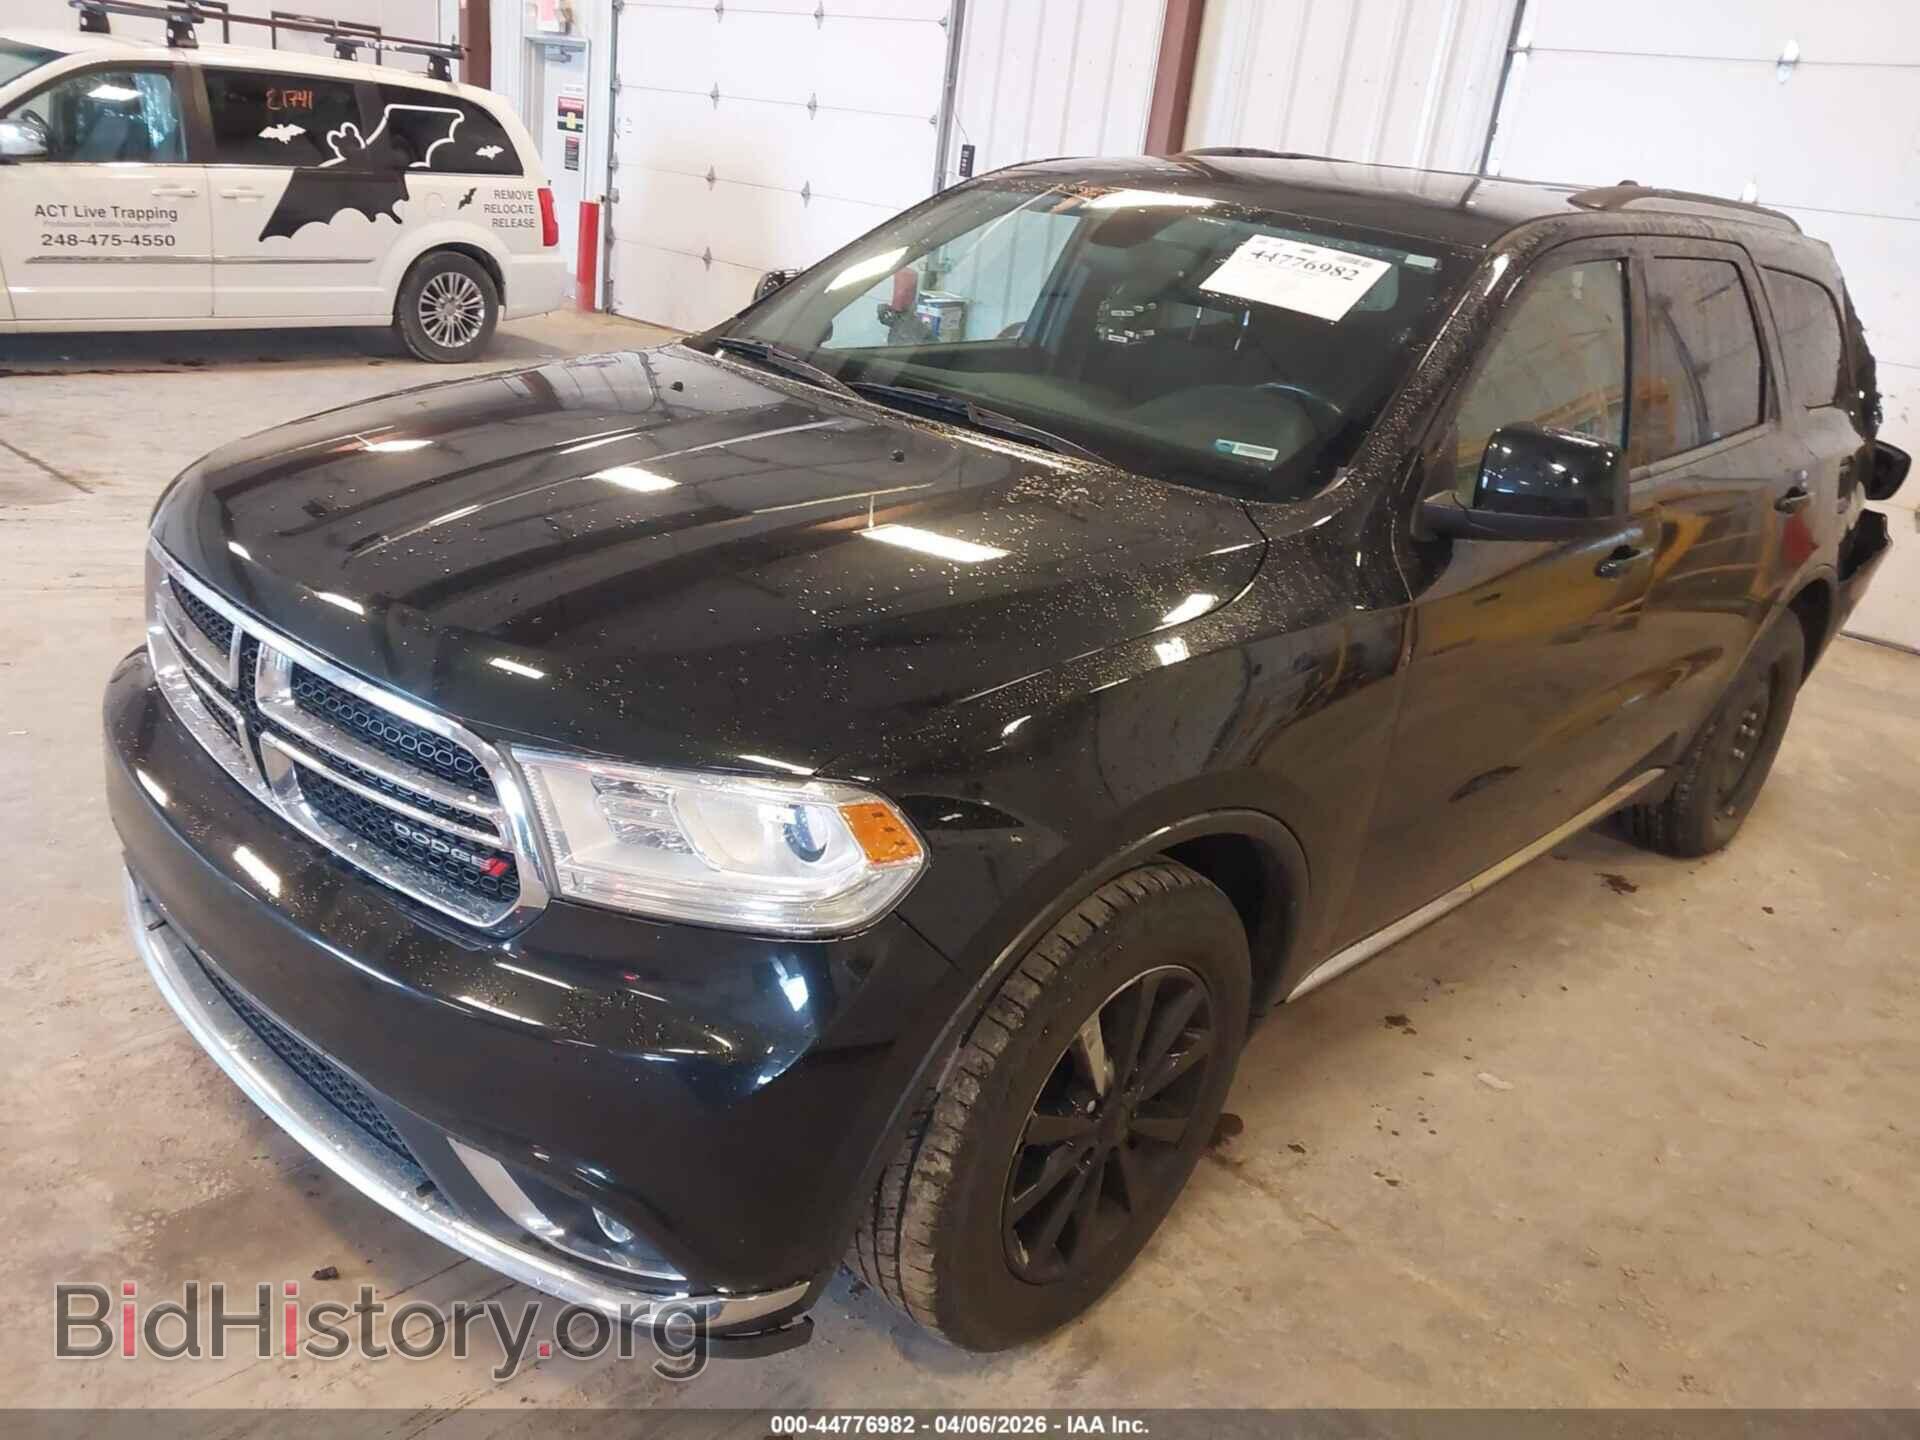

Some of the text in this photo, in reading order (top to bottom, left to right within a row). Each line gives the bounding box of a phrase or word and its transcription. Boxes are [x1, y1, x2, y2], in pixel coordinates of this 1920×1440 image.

[494, 189, 535, 201] REMOVE
[34, 204, 178, 222] ACT Live Trapping
[483, 203, 535, 214] RELOCATE
[492, 217, 536, 229] RELEASE
[41, 233, 176, 247] 248-475-4550
[1250, 249, 1361, 281] 44776982
[394, 822, 488, 869] DODGE
